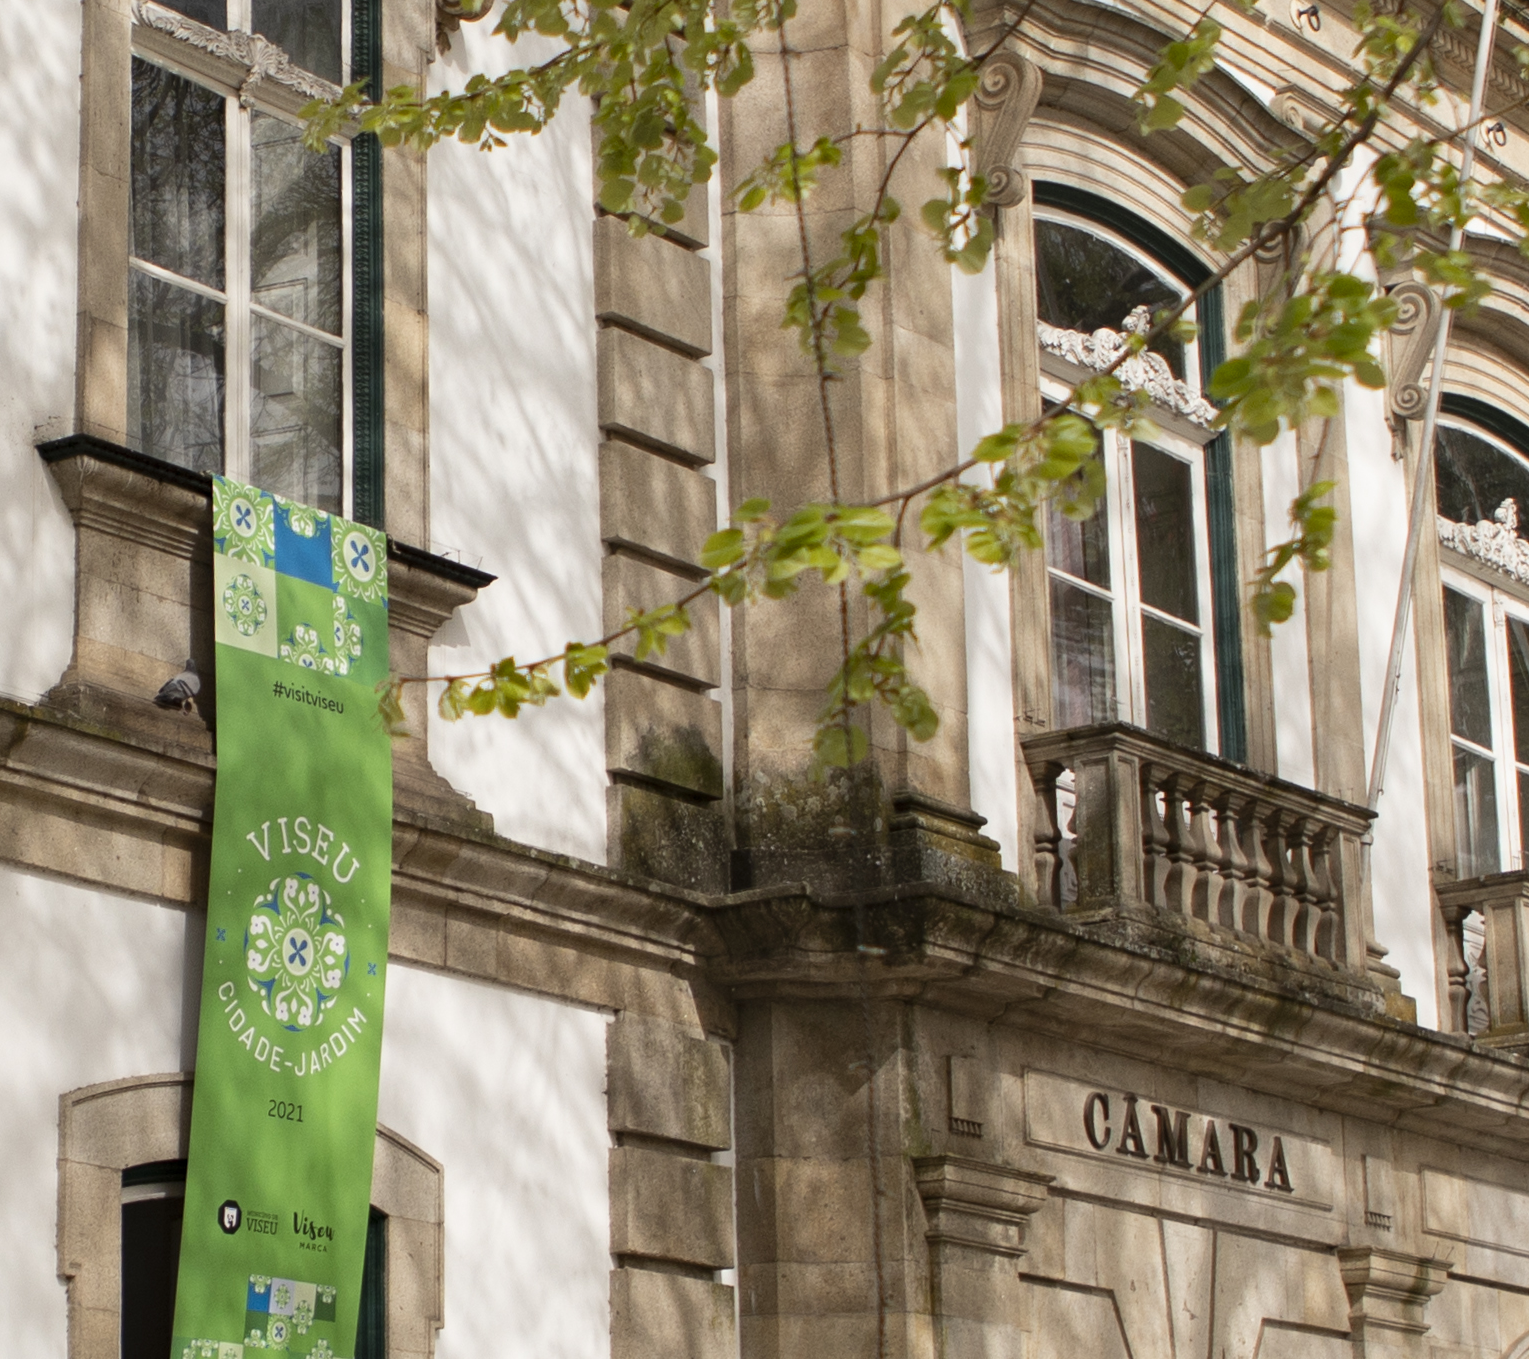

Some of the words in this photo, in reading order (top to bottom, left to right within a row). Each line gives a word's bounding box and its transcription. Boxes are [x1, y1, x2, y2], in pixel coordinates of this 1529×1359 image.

[272, 680, 345, 715] #visitviseu
[246, 816, 360, 883] VISEU
[218, 981, 367, 1077] CIDADE-JARDIM
[267, 1099, 304, 1123] 2021
[1083, 1091, 1295, 1194] CÂMARA
[246, 1217, 278, 1235] VISEU
[294, 1209, 335, 1241] Viseu
[299, 1242, 327, 1252] MARCA
